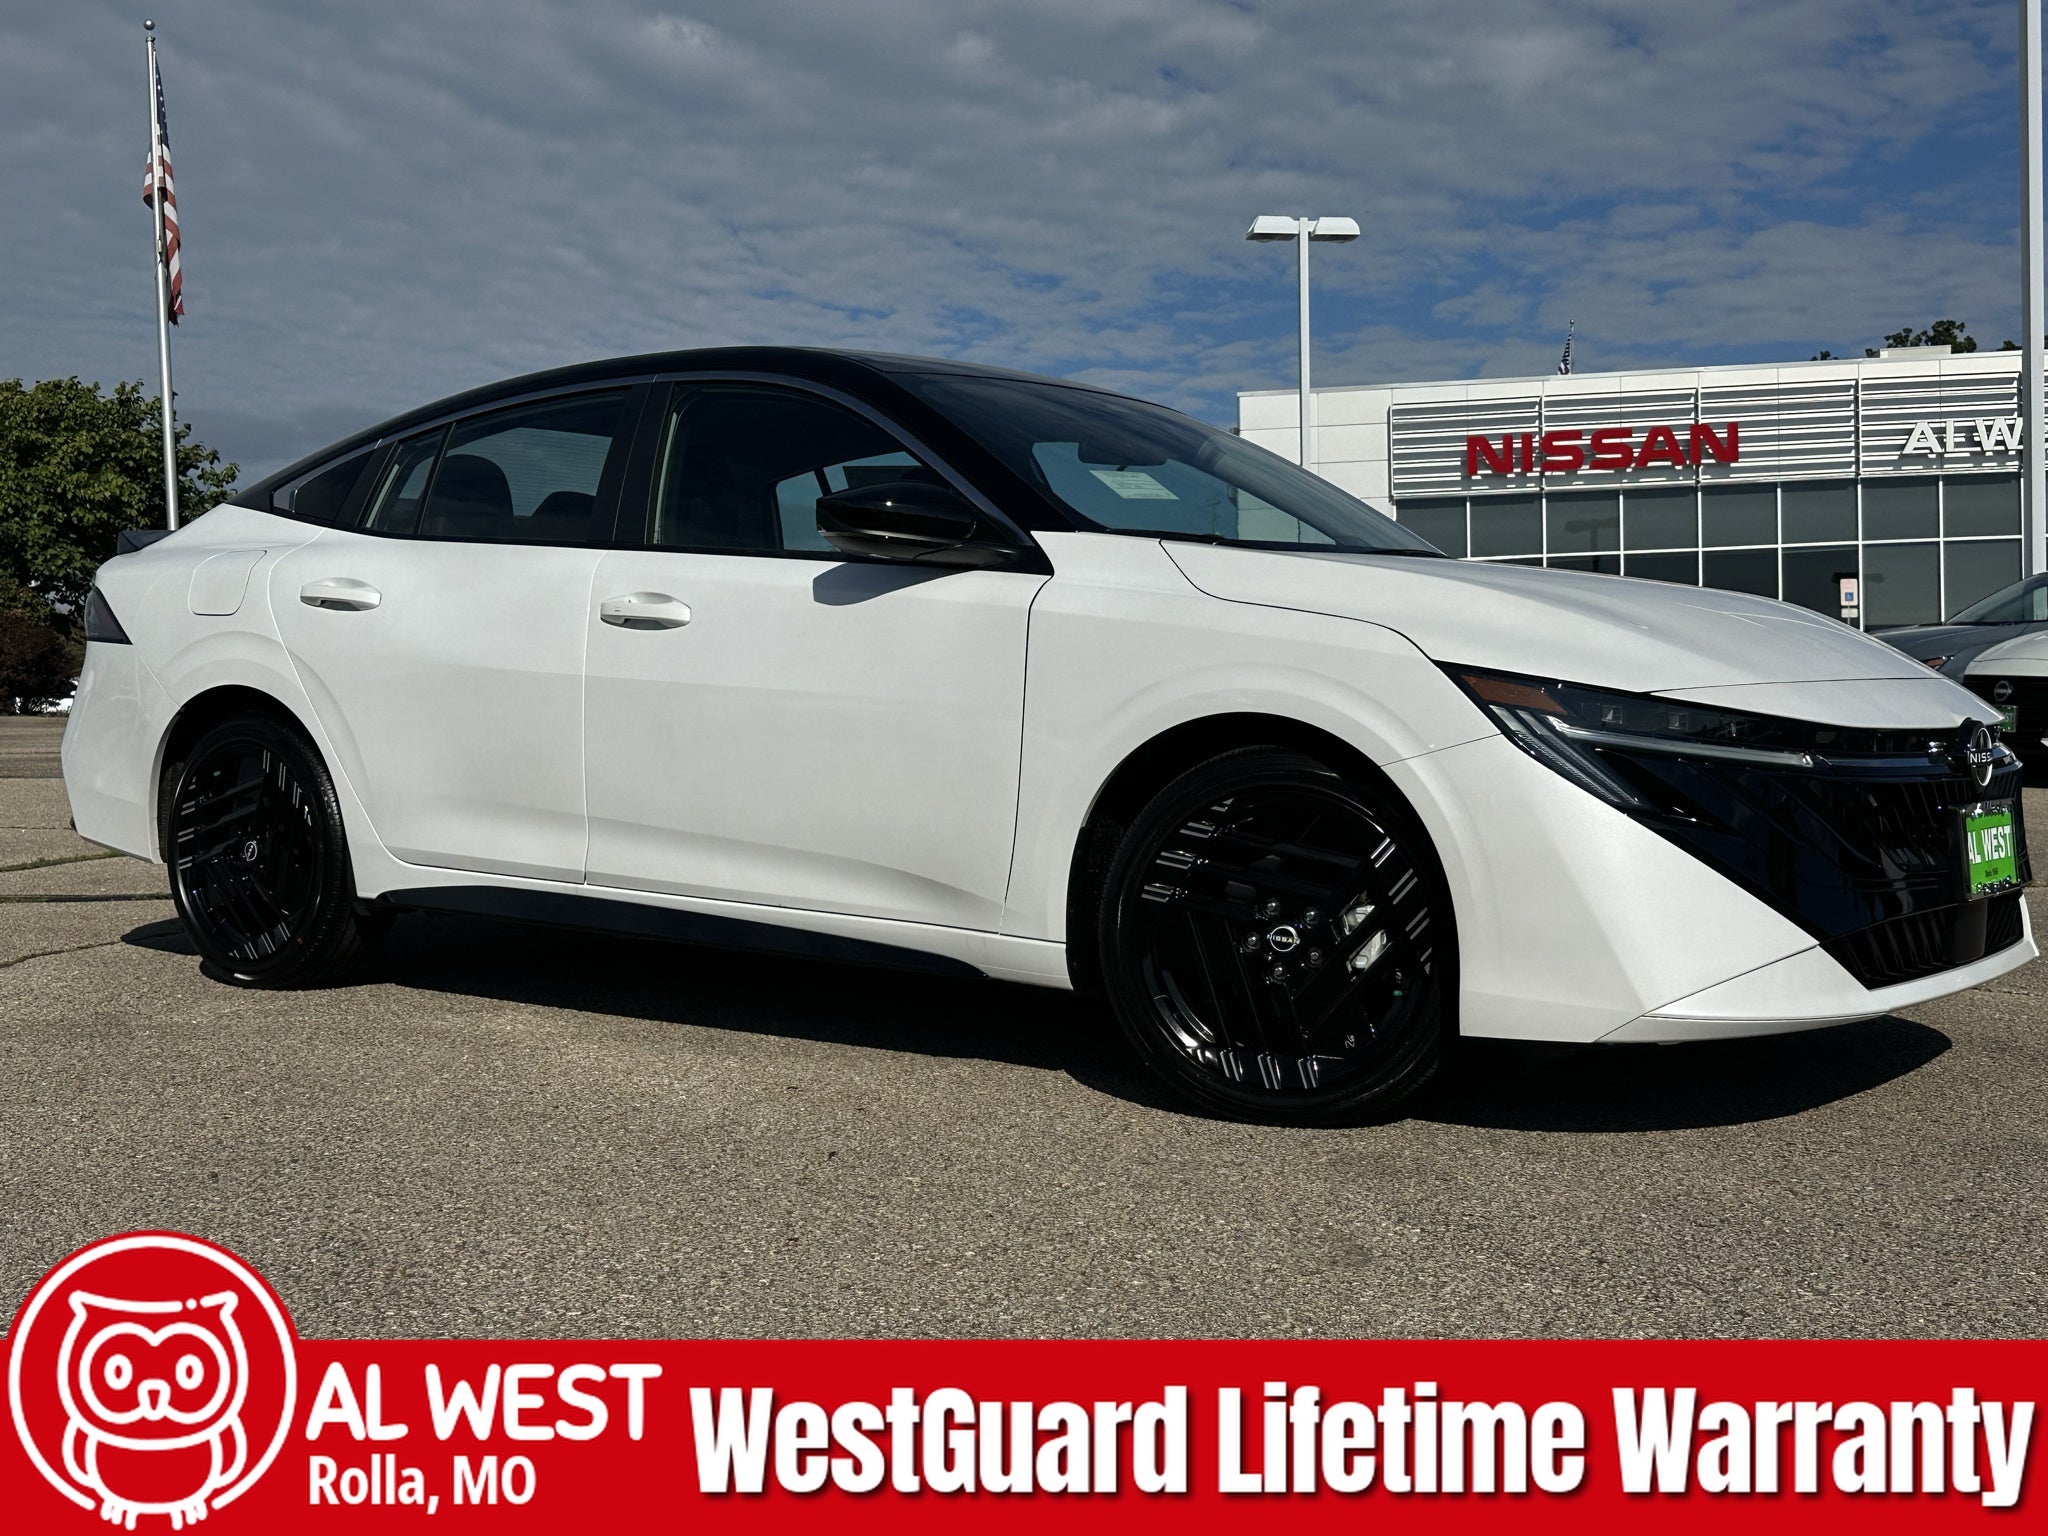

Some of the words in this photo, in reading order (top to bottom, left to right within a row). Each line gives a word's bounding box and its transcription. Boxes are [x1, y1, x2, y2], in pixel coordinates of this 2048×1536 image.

[1466, 422, 1739, 475] NISSAN
[1970, 752, 1992, 764] NISS
[1967, 830, 1982, 864] AL
[1981, 825, 2011, 862] WEST
